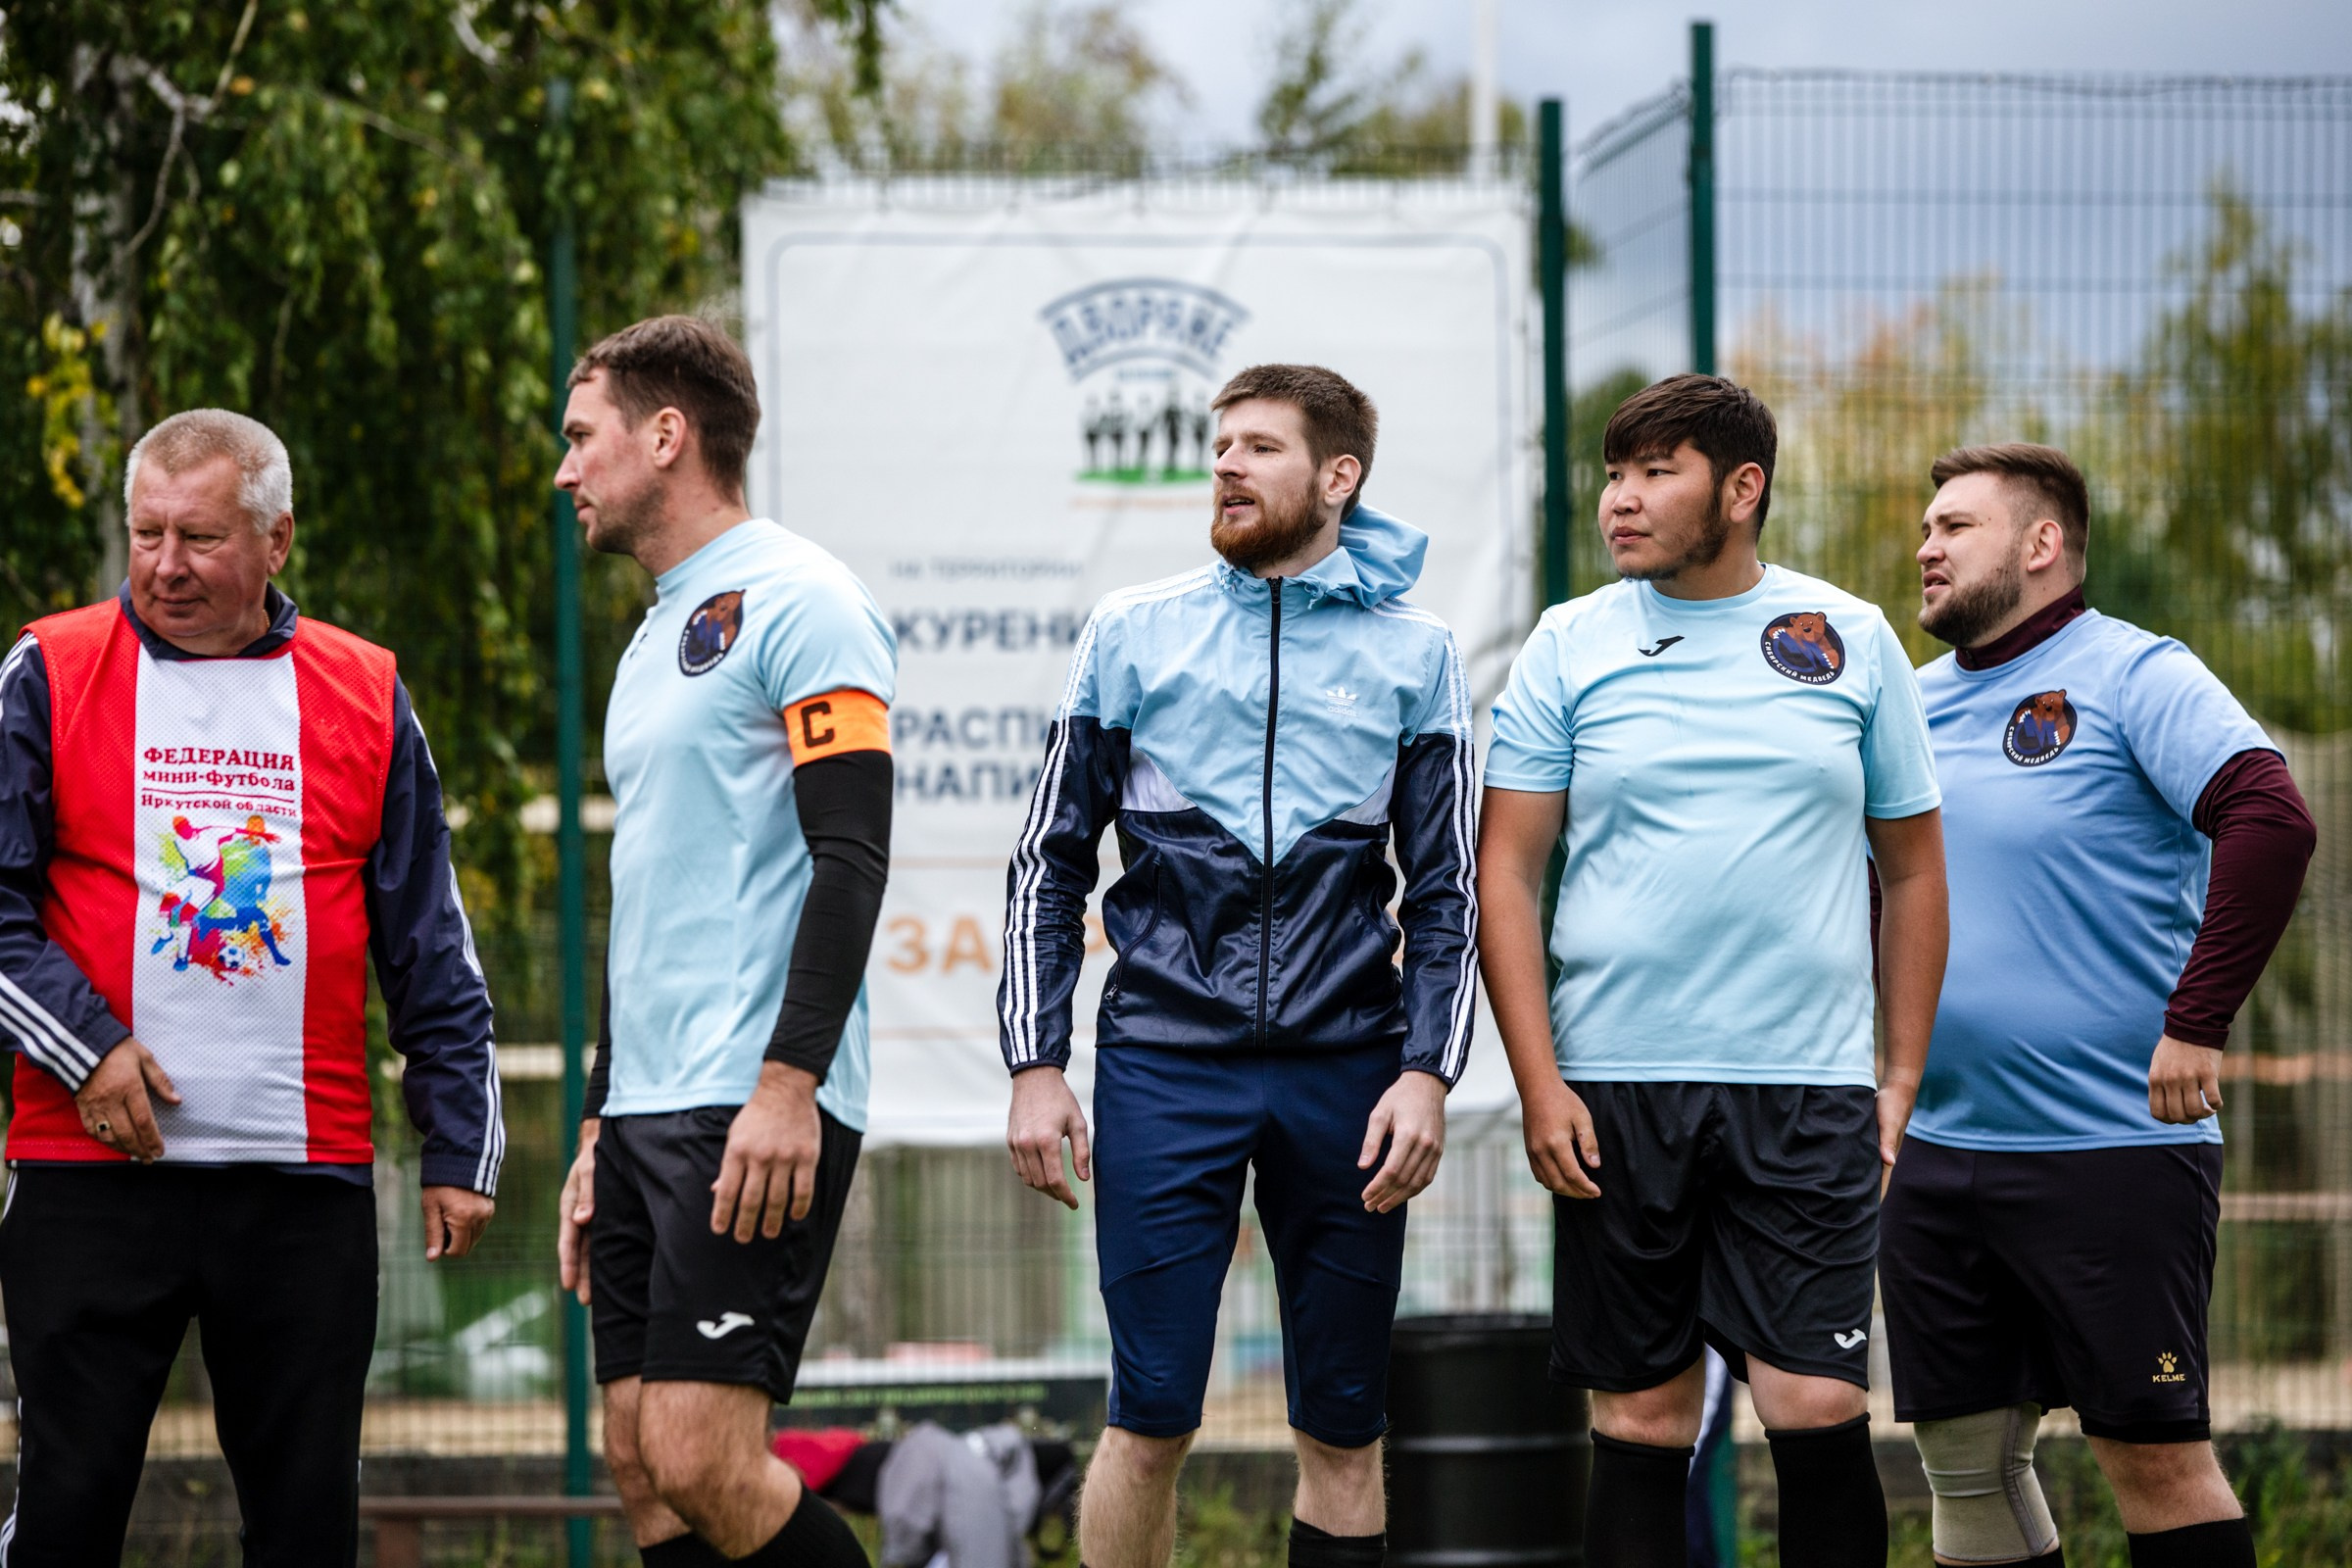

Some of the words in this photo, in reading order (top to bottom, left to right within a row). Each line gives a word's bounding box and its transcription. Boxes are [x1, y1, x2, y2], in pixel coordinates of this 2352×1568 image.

[1765, 641, 1798, 677] СИБИРСКИЙ
[1799, 670, 1835, 683] МЕДВЕДЬ
[1327, 705, 1358, 717] adidas
[2006, 725, 2024, 761] СИБИРСКИЙ
[2023, 747, 2059, 764] МЕДВЕДЬ
[143, 747, 295, 771] ФЕДЕРАЦИЯ
[143, 769, 295, 792] мини-футбола
[141, 794, 232, 810] Иркутской
[234, 801, 298, 817] области
[2152, 1373, 2186, 1384] KELME
